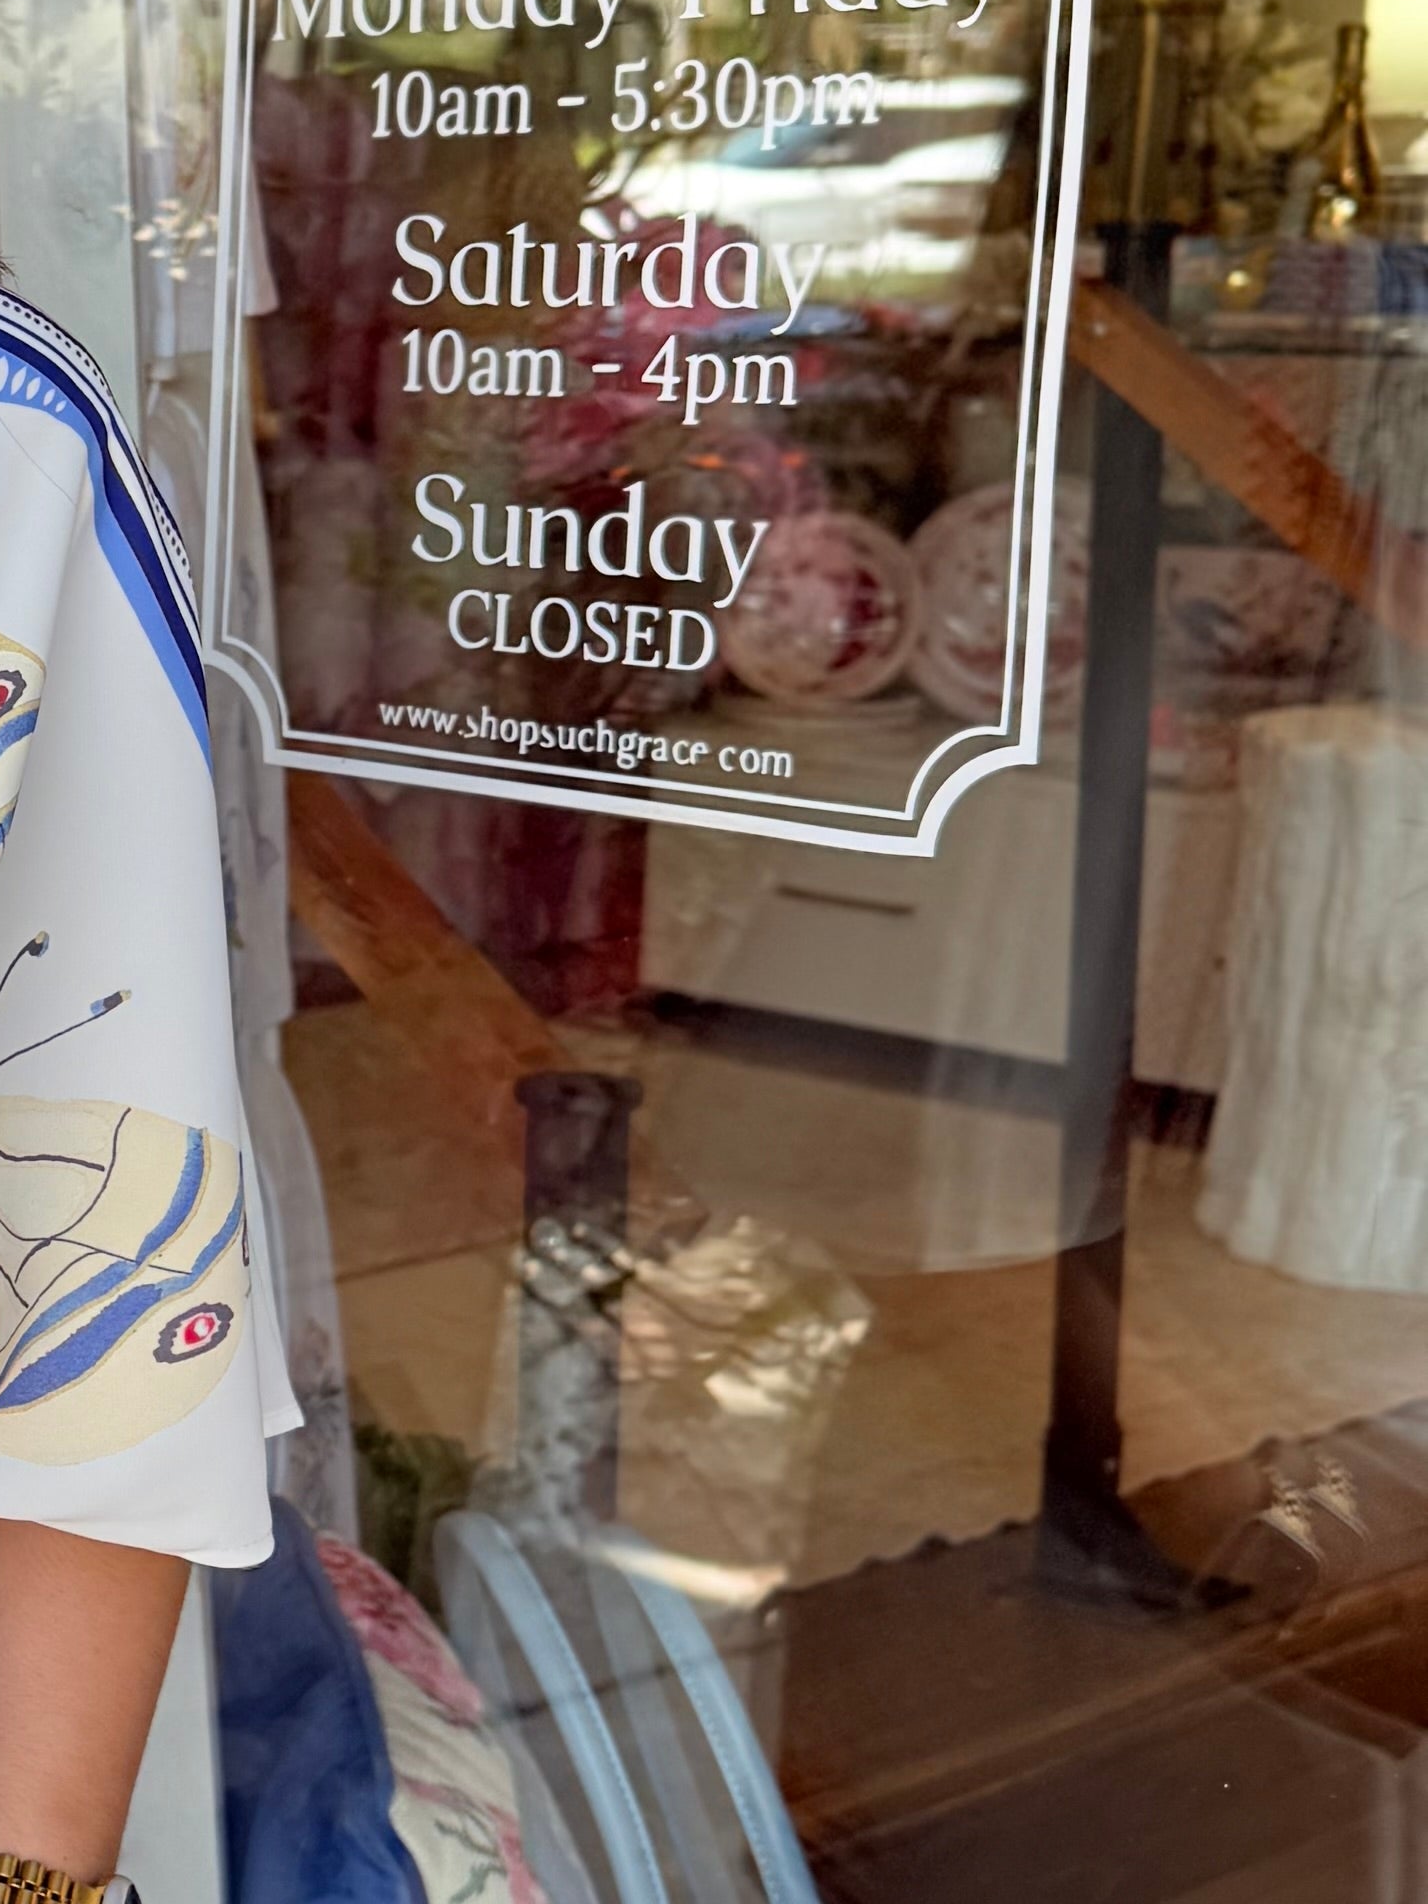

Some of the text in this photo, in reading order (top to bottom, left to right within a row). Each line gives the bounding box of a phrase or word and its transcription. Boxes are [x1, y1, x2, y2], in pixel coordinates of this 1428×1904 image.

[370, 70, 532, 139] 10am
[611, 56, 883, 152] 5:30pm
[391, 212, 830, 335] Saturday
[400, 328, 566, 399] 10am
[640, 334, 800, 425] 4pm
[411, 472, 769, 609] Sunday
[447, 588, 717, 672] CLOSED
[378, 700, 794, 780] www.shopsuchgracecom
